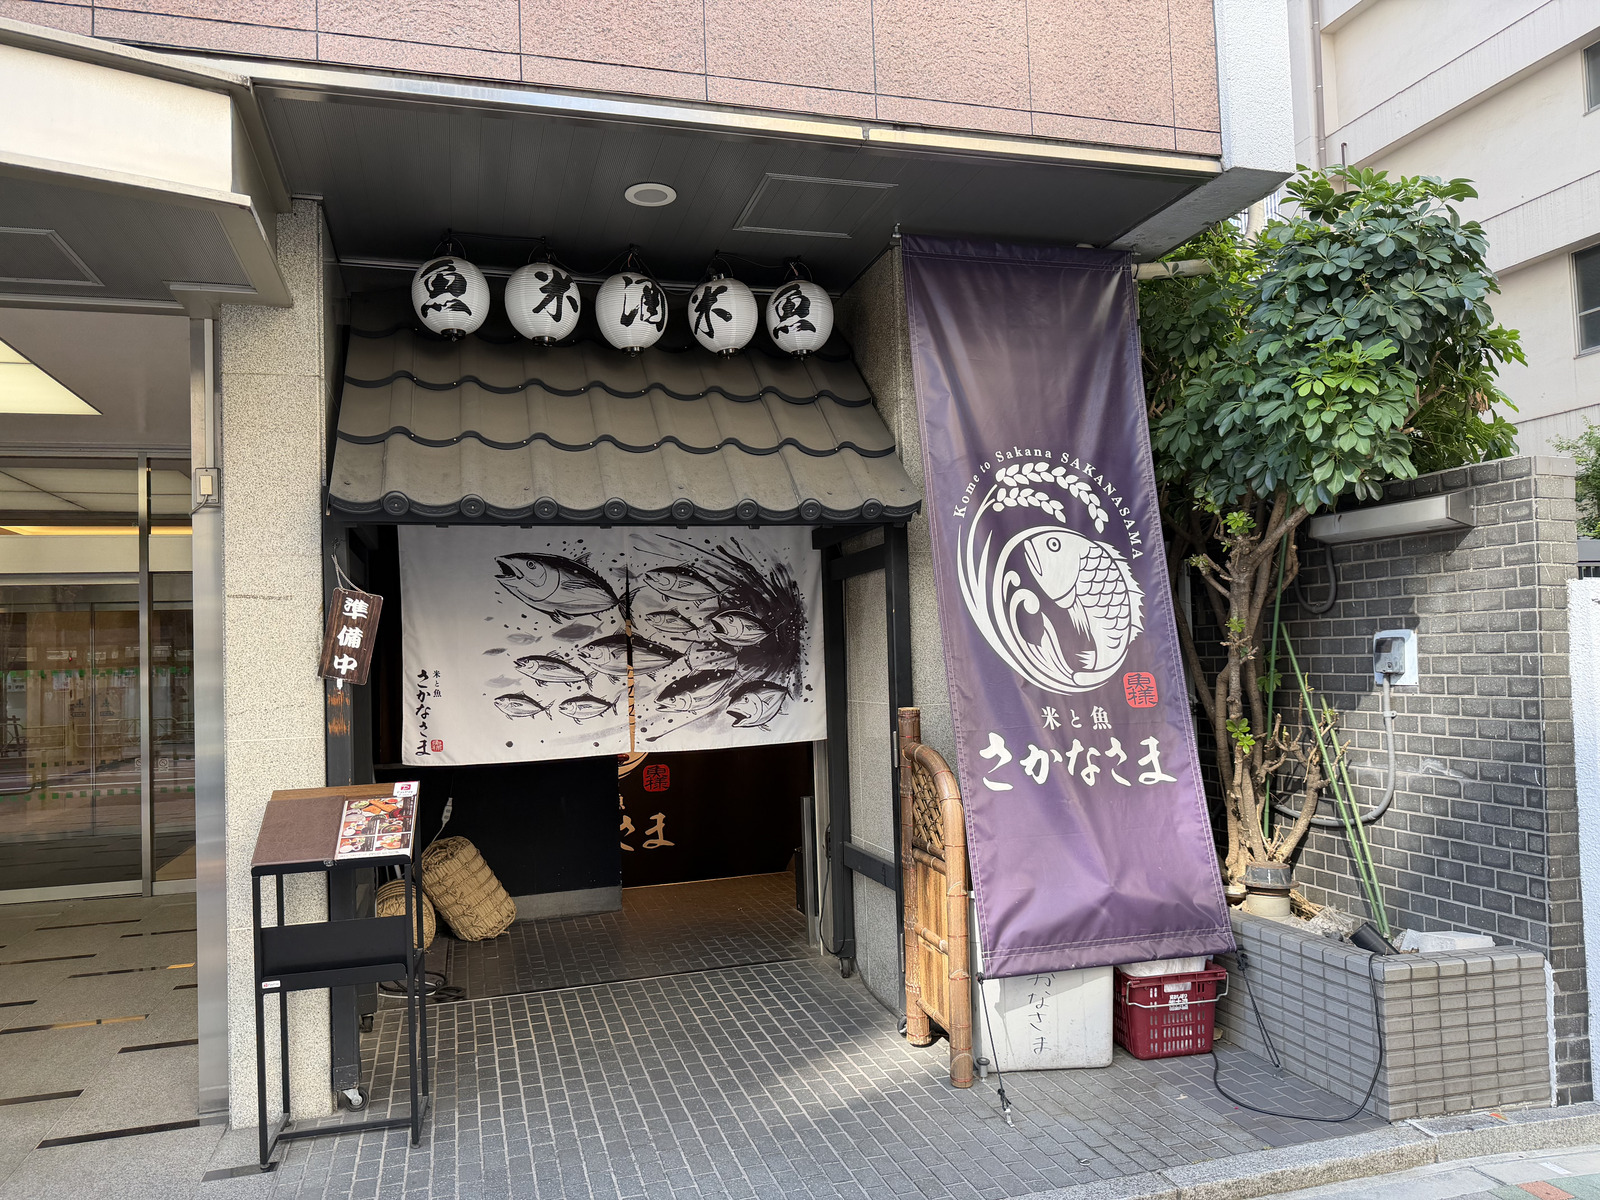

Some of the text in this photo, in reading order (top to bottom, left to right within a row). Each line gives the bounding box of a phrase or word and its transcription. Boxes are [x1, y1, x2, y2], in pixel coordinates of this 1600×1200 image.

[531, 268, 579, 323] 米
[691, 285, 733, 339] 米
[953, 446, 1144, 560] Kome to Sakana SAKANASAMA
[333, 596, 370, 676] 準備中
[415, 668, 432, 757] さかなさま
[432, 668, 443, 699] 米と魚
[1041, 704, 1113, 732] 米と魚
[979, 731, 1178, 792] さかなさま
